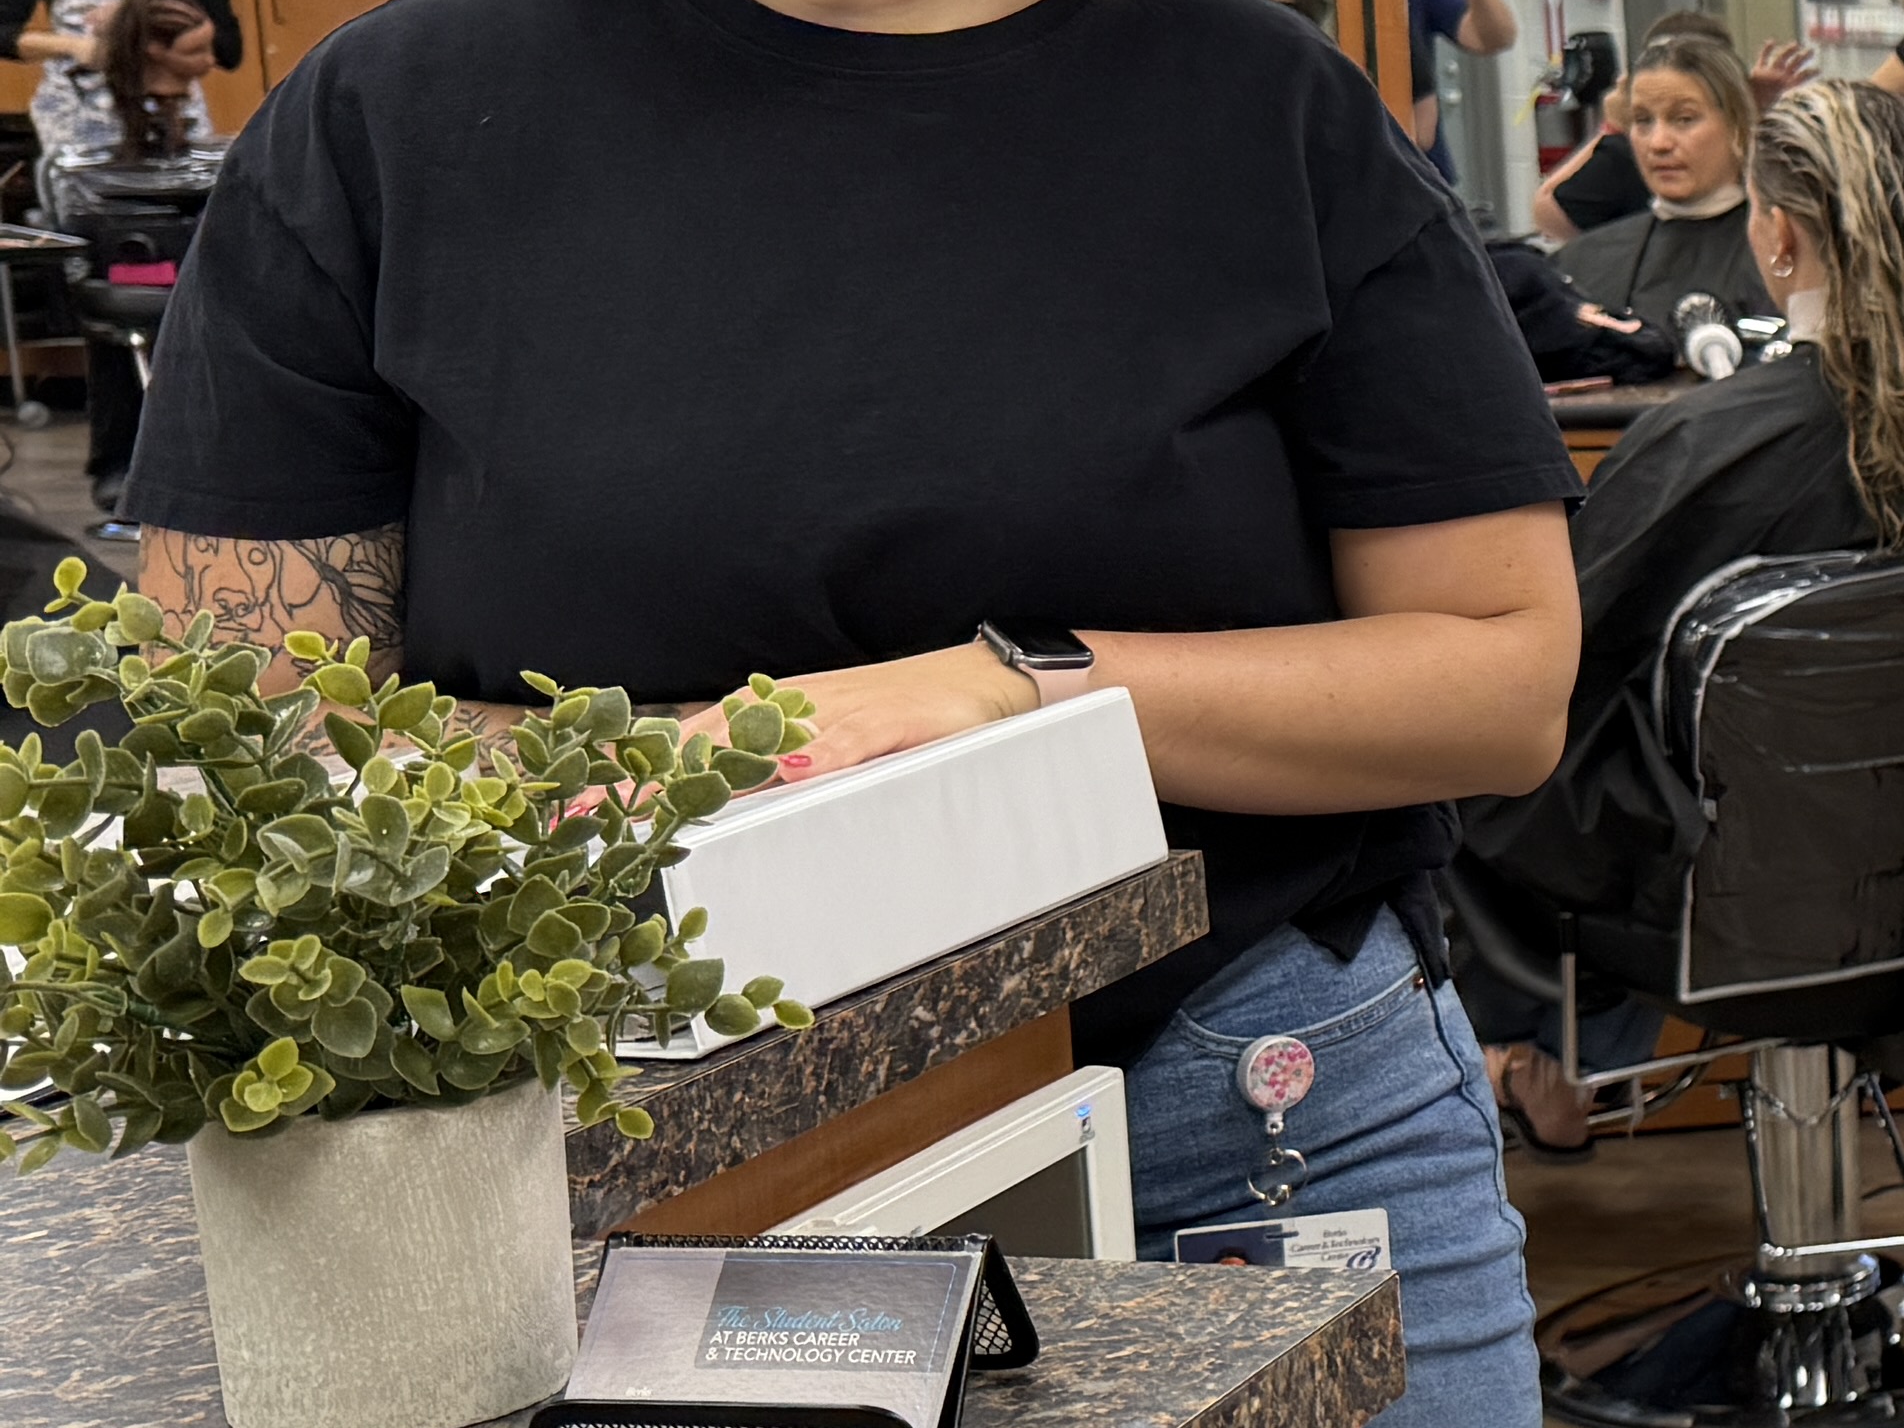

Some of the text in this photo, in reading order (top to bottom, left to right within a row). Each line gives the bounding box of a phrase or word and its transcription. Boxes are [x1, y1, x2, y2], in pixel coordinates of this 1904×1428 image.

[716, 1305, 903, 1333] The Student Salon
[710, 1331, 860, 1347] AT BERKS CAREER
[705, 1347, 918, 1365] & TECHNOLOGY CENTER
